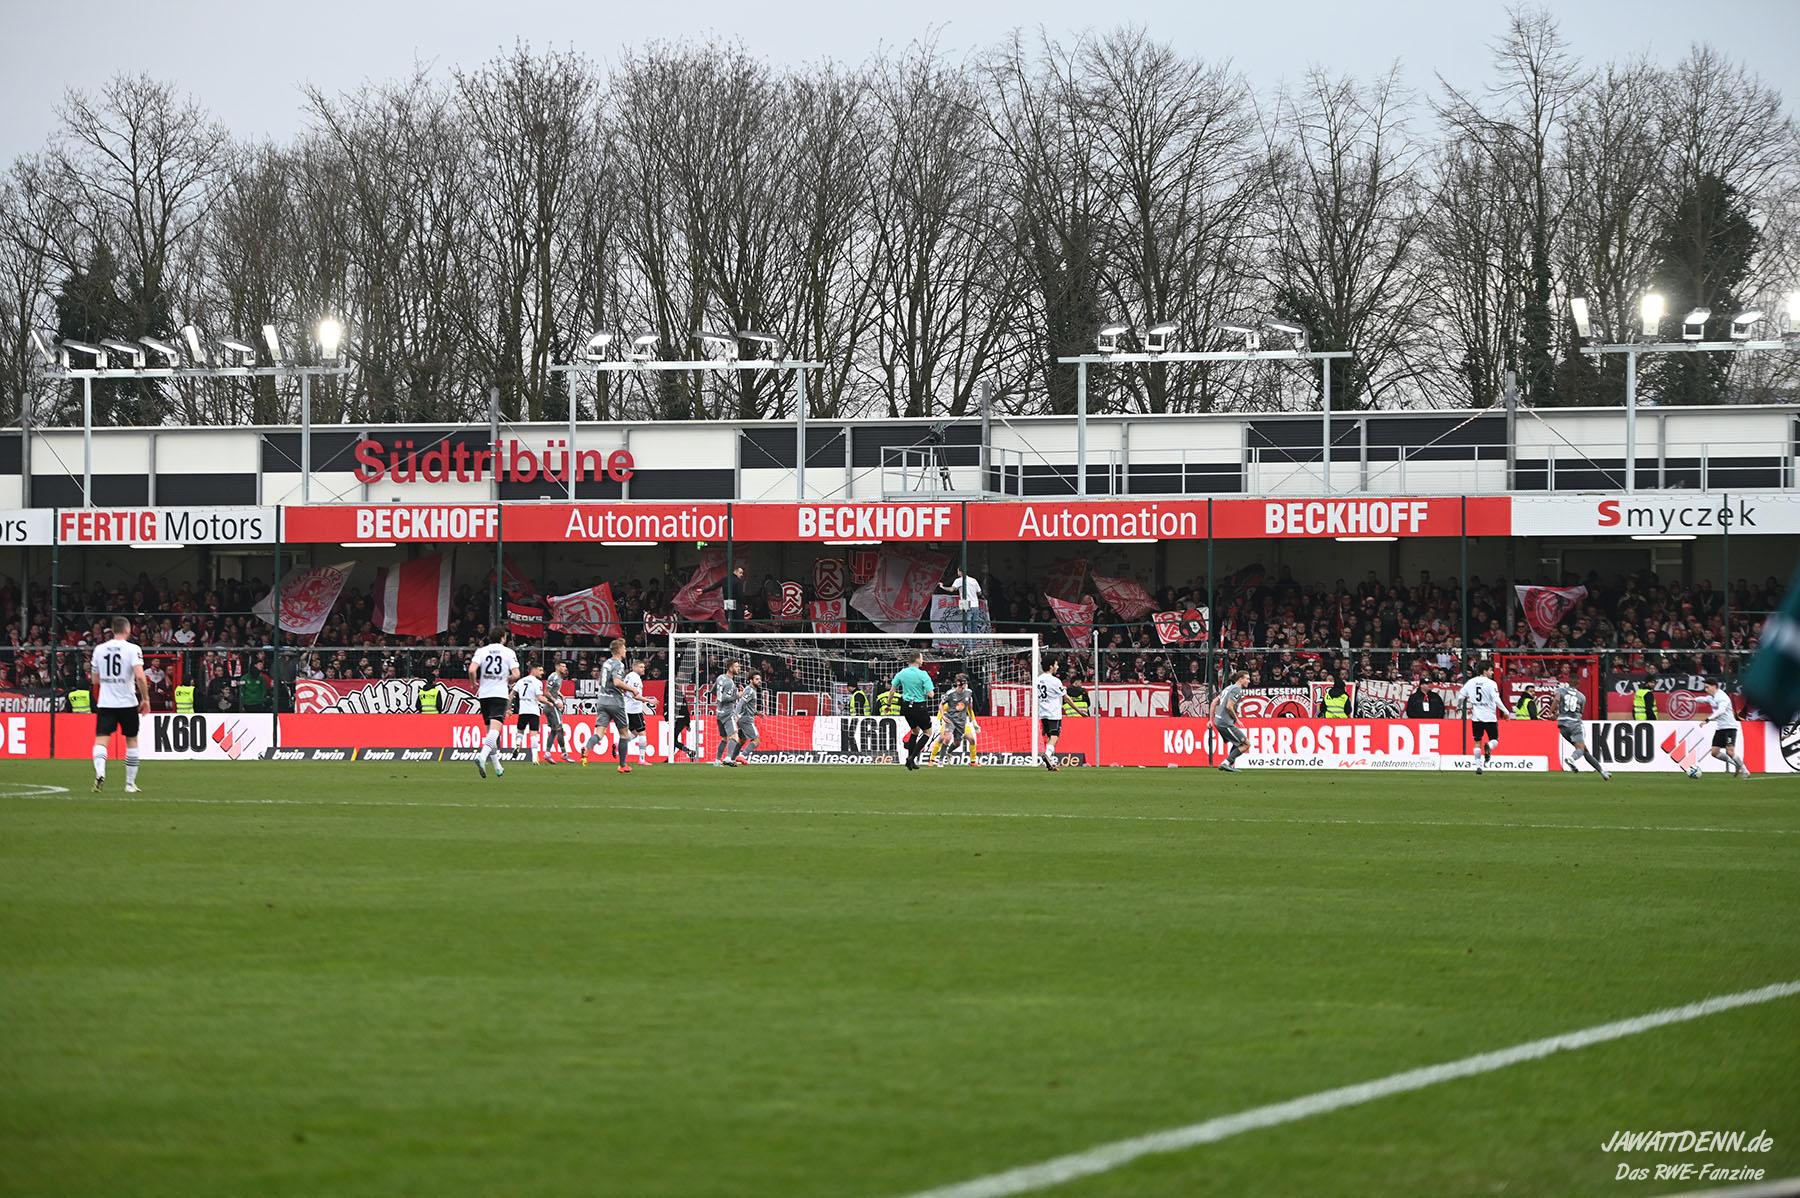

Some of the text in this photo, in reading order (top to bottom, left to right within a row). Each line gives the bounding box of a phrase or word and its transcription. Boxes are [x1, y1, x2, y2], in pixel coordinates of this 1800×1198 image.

[354, 439, 634, 484] Südtribüne
[0, 518, 28, 542] rs
[60, 511, 263, 541] FERTIG Motors
[357, 508, 498, 539] BECKHOFF
[565, 506, 734, 538] Automation
[798, 506, 951, 538] BECKHOFF
[1017, 504, 1198, 537] Automation
[1265, 502, 1428, 534] BECKHOFF
[1597, 499, 1757, 534] Smyczek
[104, 653, 122, 676] 16
[485, 655, 502, 675] 23
[523, 683, 531, 697] 7
[1268, 687, 1309, 696] ESSENER
[1475, 686, 1483, 702] 5
[0, 717, 27, 755] E
[154, 715, 208, 753] K60
[840, 717, 897, 751] K60
[1591, 722, 1655, 763] K60
[272, 749, 345, 760] bwin bwin
[363, 749, 433, 760] bwin bwin
[747, 751, 893, 766] isenbach Tresore.de
[1248, 756, 1324, 767] wa-strom.de
[1371, 758, 1437, 768] notstromtechnik
[1454, 757, 1534, 769] wa-trom.de
